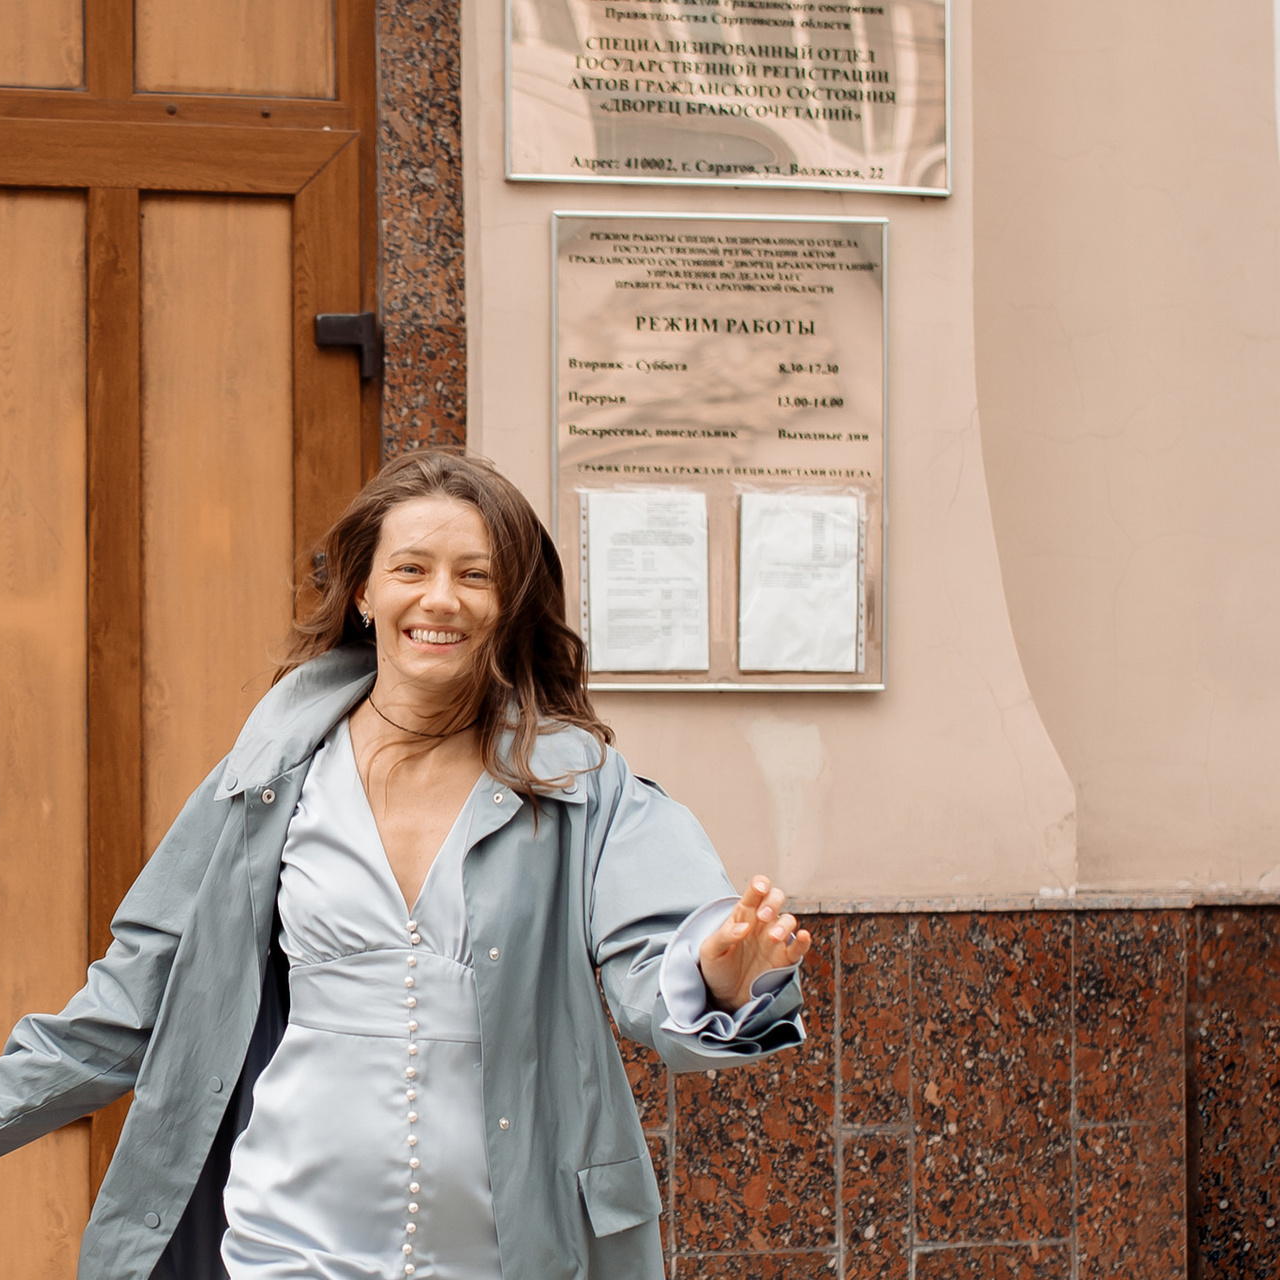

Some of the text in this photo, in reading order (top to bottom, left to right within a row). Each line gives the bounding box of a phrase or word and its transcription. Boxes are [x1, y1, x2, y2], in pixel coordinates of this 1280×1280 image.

[586, 36, 876, 64] СПЕЦИАЛИЗИРОВАННЫЙ ОТДЕЛ
[575, 55, 890, 83] ГОСУДАРСТВЕННОЙ РЕГИСТРАЦИИ
[569, 76, 897, 104] АКТОВ ГРАЖДАНСКОГО СОСТОЯНИЯ
[600, 98, 862, 121] «ДВОРЕЦ БРАКОСОЧЕТАНИЙ»
[571, 155, 619, 170] Адрес:
[870, 166, 885, 179] 22
[636, 316, 816, 336] РЕЖИМ РАБОТЫ
[568, 358, 624, 373] Вторник
[636, 359, 688, 374] Суббота
[568, 391, 627, 406] Перерыв
[778, 428, 843, 442] Выходные
